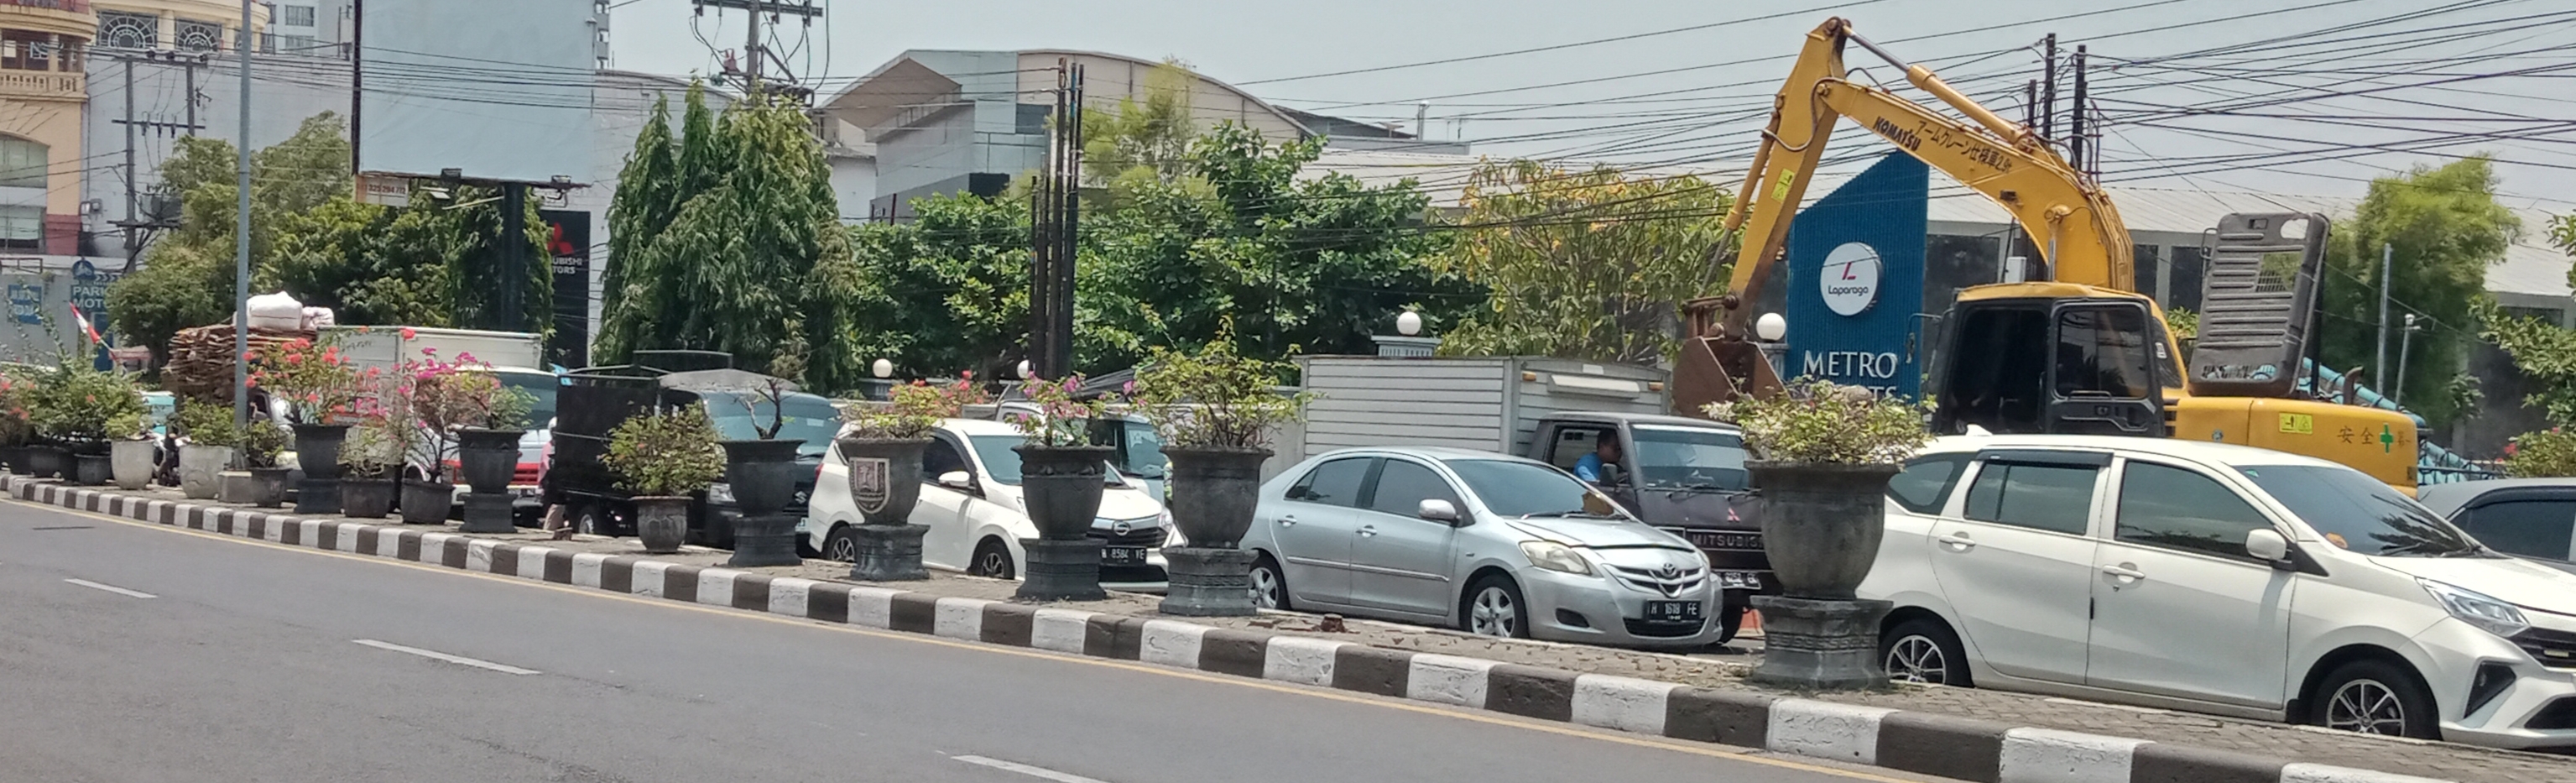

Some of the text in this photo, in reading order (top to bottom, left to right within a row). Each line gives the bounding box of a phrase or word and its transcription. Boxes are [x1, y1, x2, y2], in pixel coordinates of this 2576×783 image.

[1872, 116, 1922, 152] KOMATSU
[1803, 349, 1897, 378] METRO
[2337, 425, 2374, 445] 安全
[1692, 534, 1762, 547] MITSUBIS
